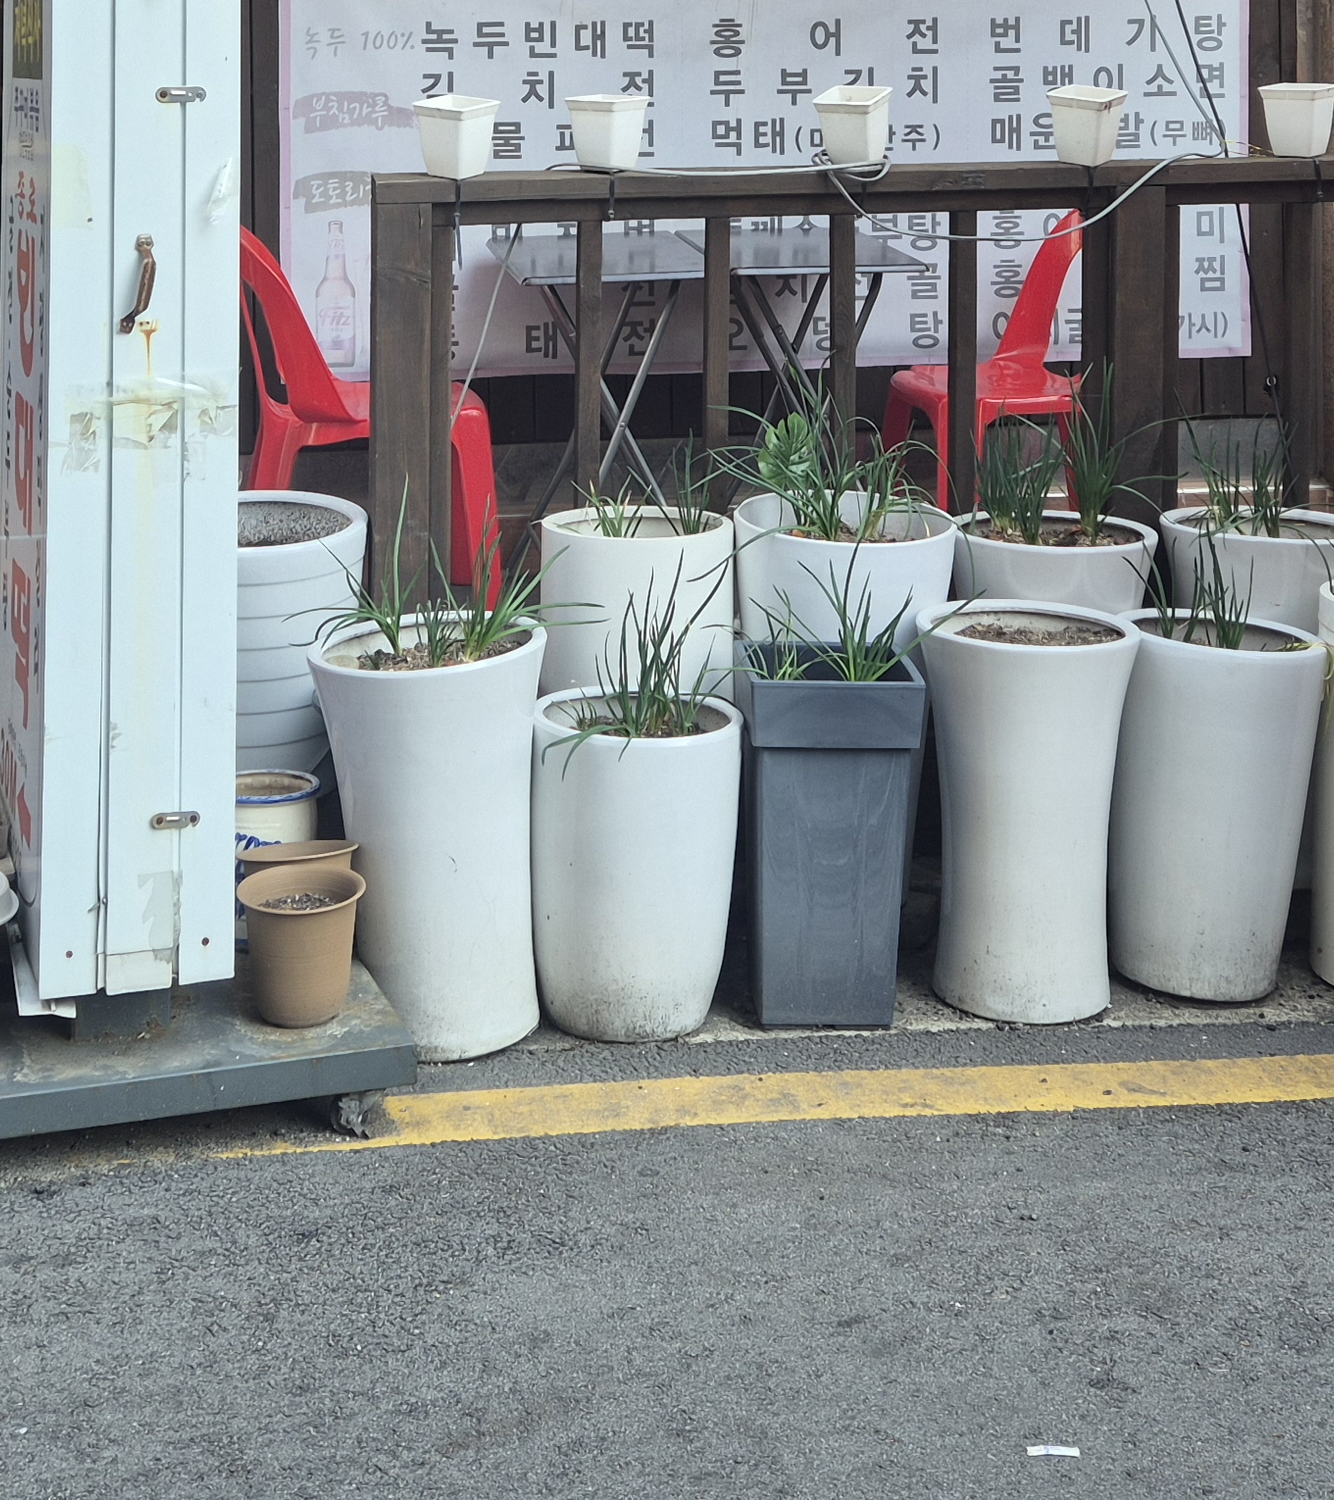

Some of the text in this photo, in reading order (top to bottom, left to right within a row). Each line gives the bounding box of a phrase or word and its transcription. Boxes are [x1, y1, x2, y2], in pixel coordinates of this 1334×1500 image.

[304, 26, 416, 60] 녹두 100%
[310, 95, 389, 129] 부침가루
